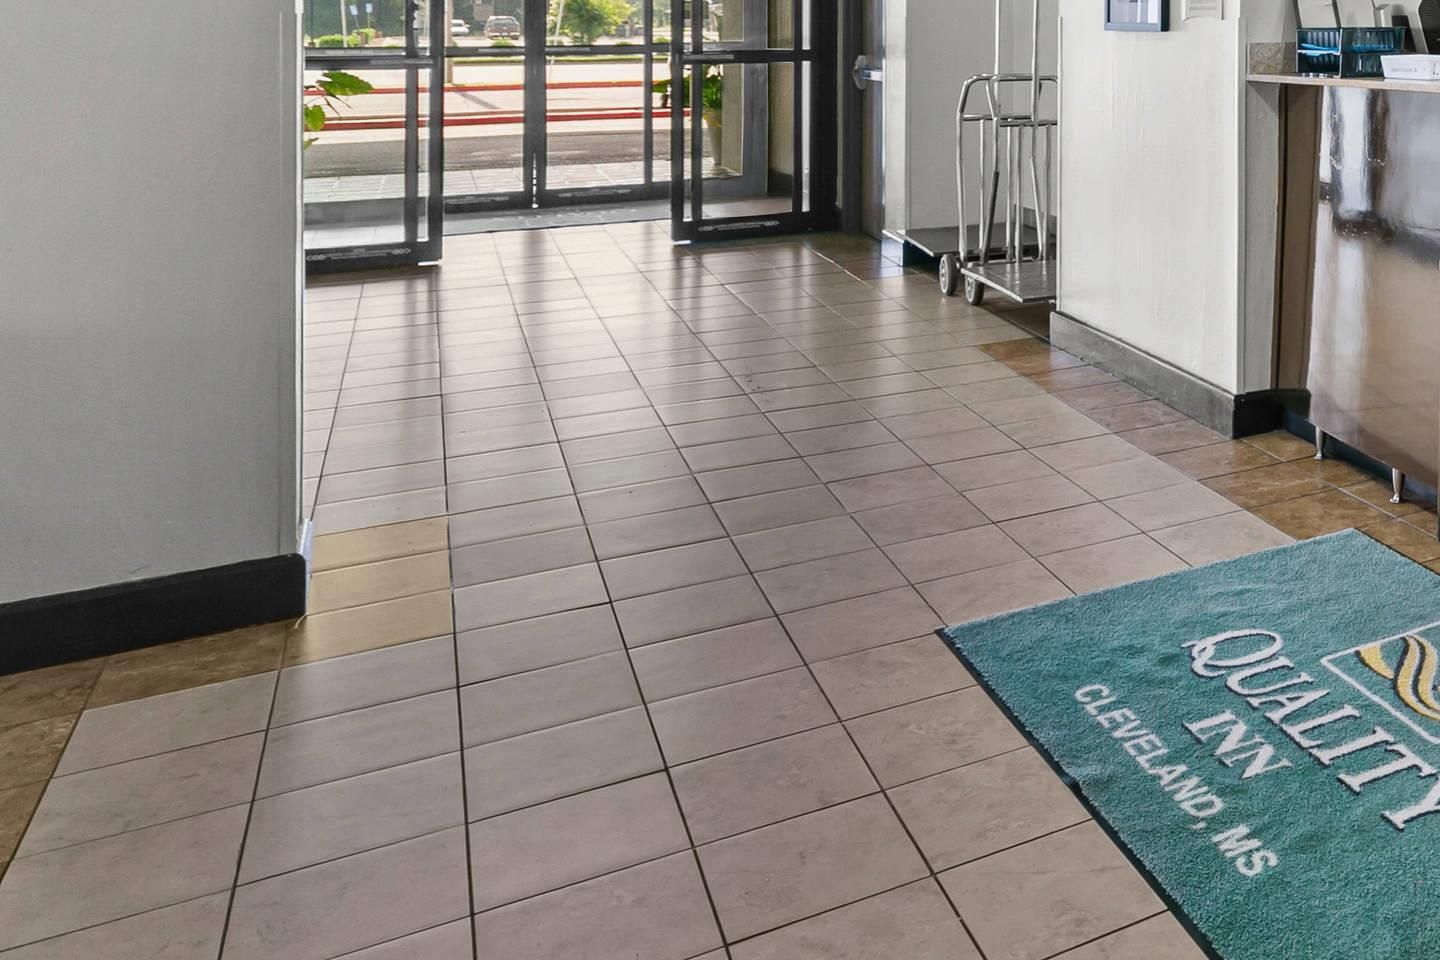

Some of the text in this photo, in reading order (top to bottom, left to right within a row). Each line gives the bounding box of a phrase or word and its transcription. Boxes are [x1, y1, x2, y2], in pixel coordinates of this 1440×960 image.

[1074, 683, 1279, 878] CLEVELAND, MS
[1183, 709, 1292, 779] INN
